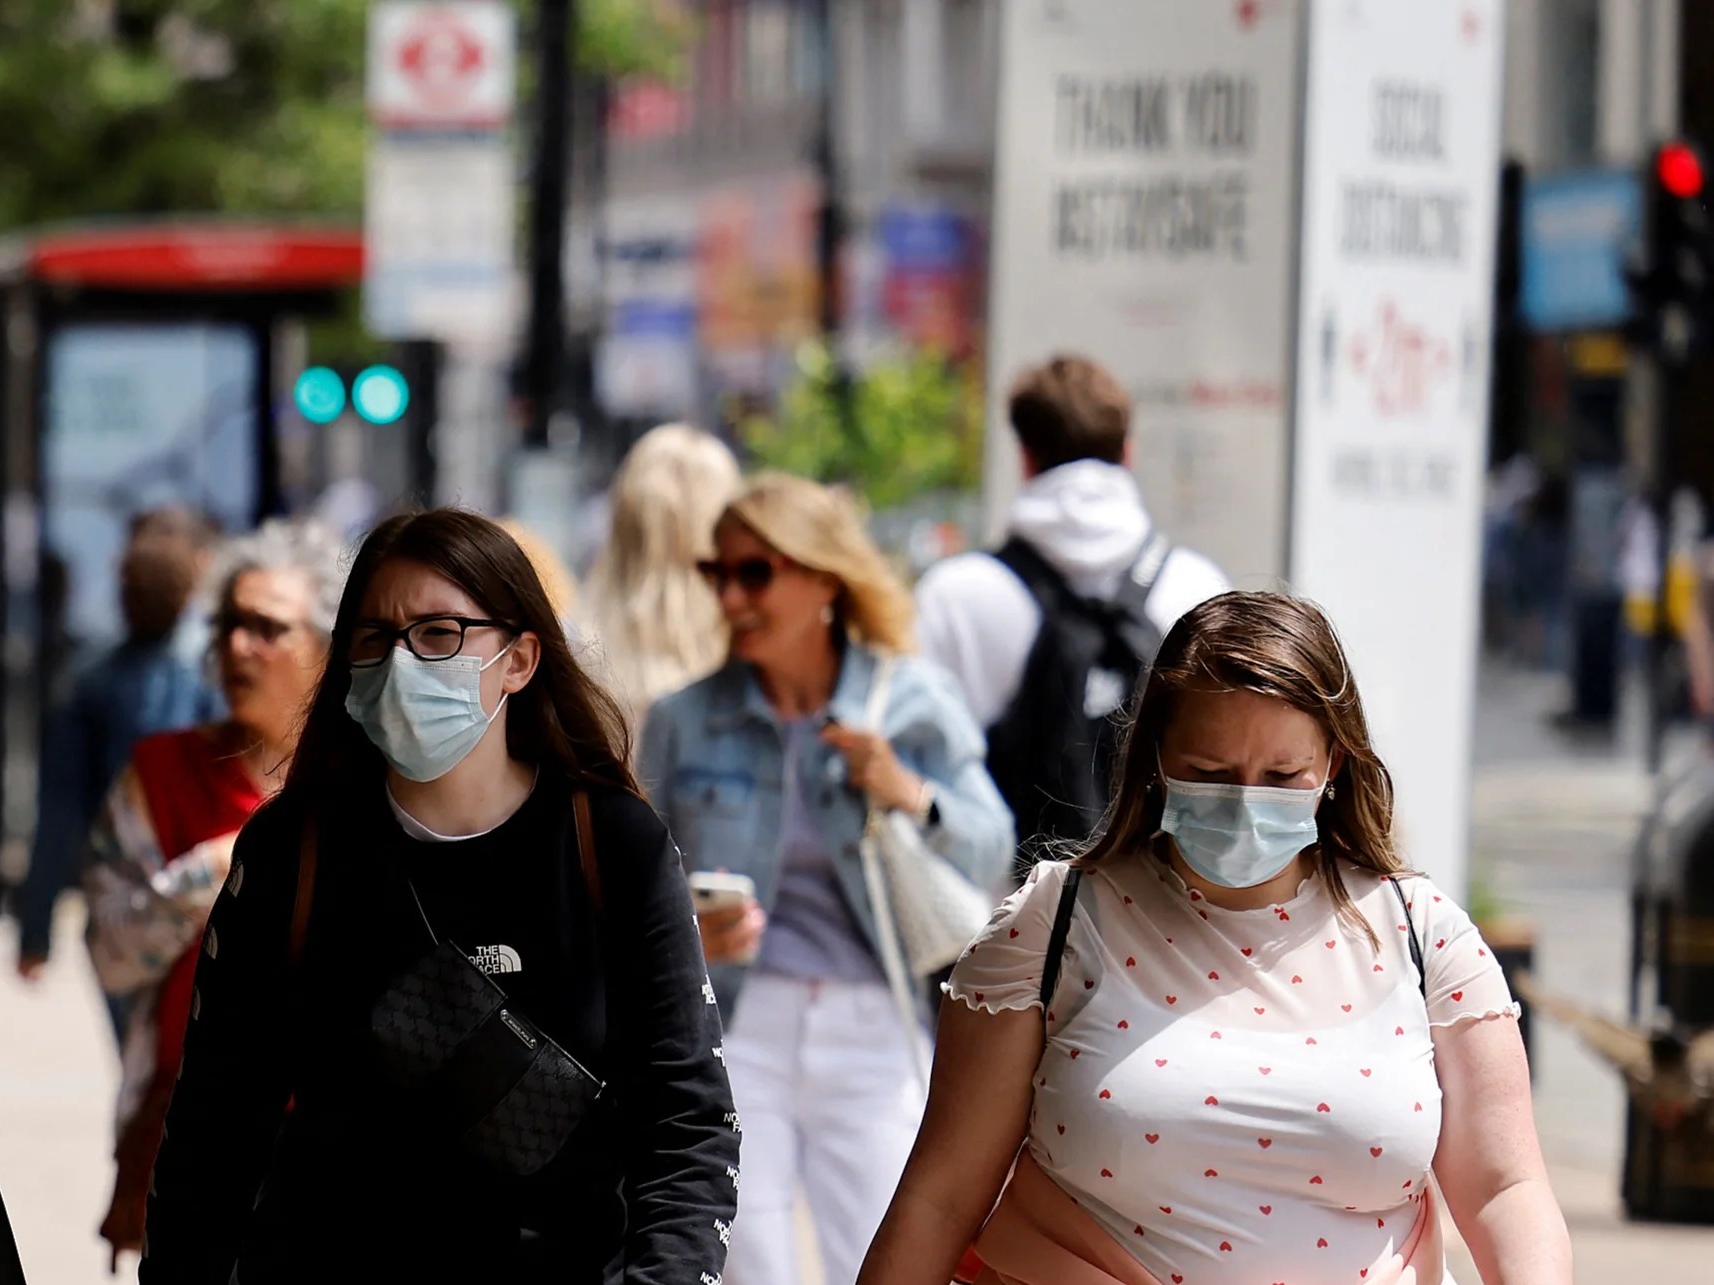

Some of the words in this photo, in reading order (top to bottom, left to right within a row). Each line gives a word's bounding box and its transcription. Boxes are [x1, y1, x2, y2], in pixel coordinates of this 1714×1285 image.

[476, 945, 498, 955] THE
[468, 955, 500, 965] ORTH
[478, 963, 500, 974] ACE
